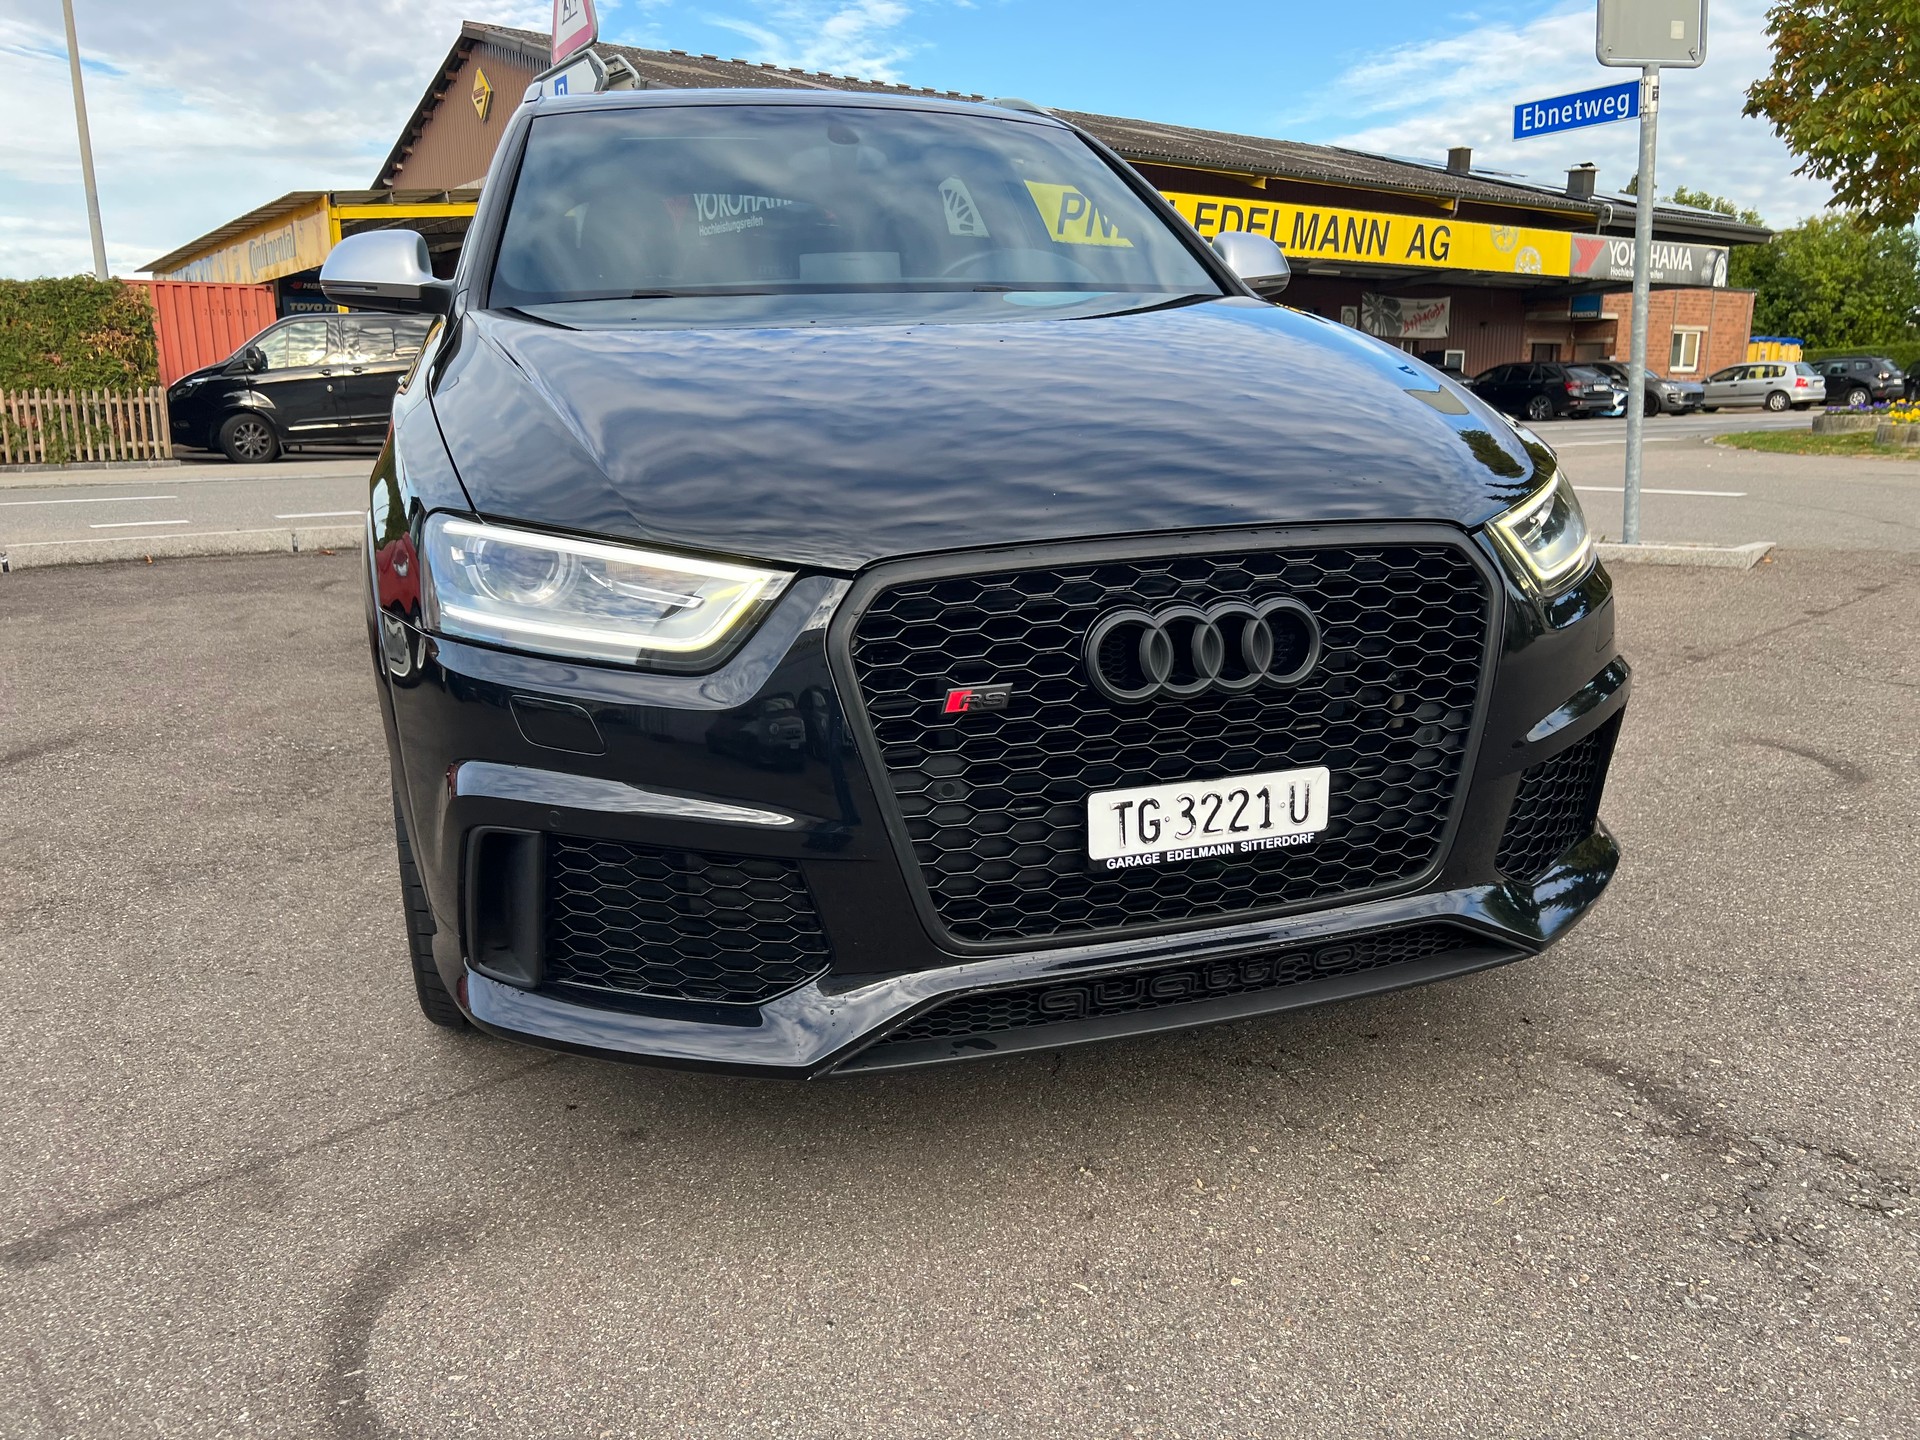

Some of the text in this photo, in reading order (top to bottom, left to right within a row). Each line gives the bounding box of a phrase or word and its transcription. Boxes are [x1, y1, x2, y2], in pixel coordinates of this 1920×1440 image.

[1522, 93, 1630, 131] Ebnetweg
[249, 223, 297, 278] Continental
[1194, 202, 1390, 257] EDELMANN
[1406, 223, 1452, 262] AG
[1608, 240, 1693, 272] YOKHAMA
[289, 303, 324, 312] TOYO
[959, 690, 1008, 711] RS
[1110, 777, 1313, 849] TG 3221 U
[1106, 833, 1315, 870] GARAGE EDELMANN SITTERDORF
[1039, 945, 1357, 1018] quattro
